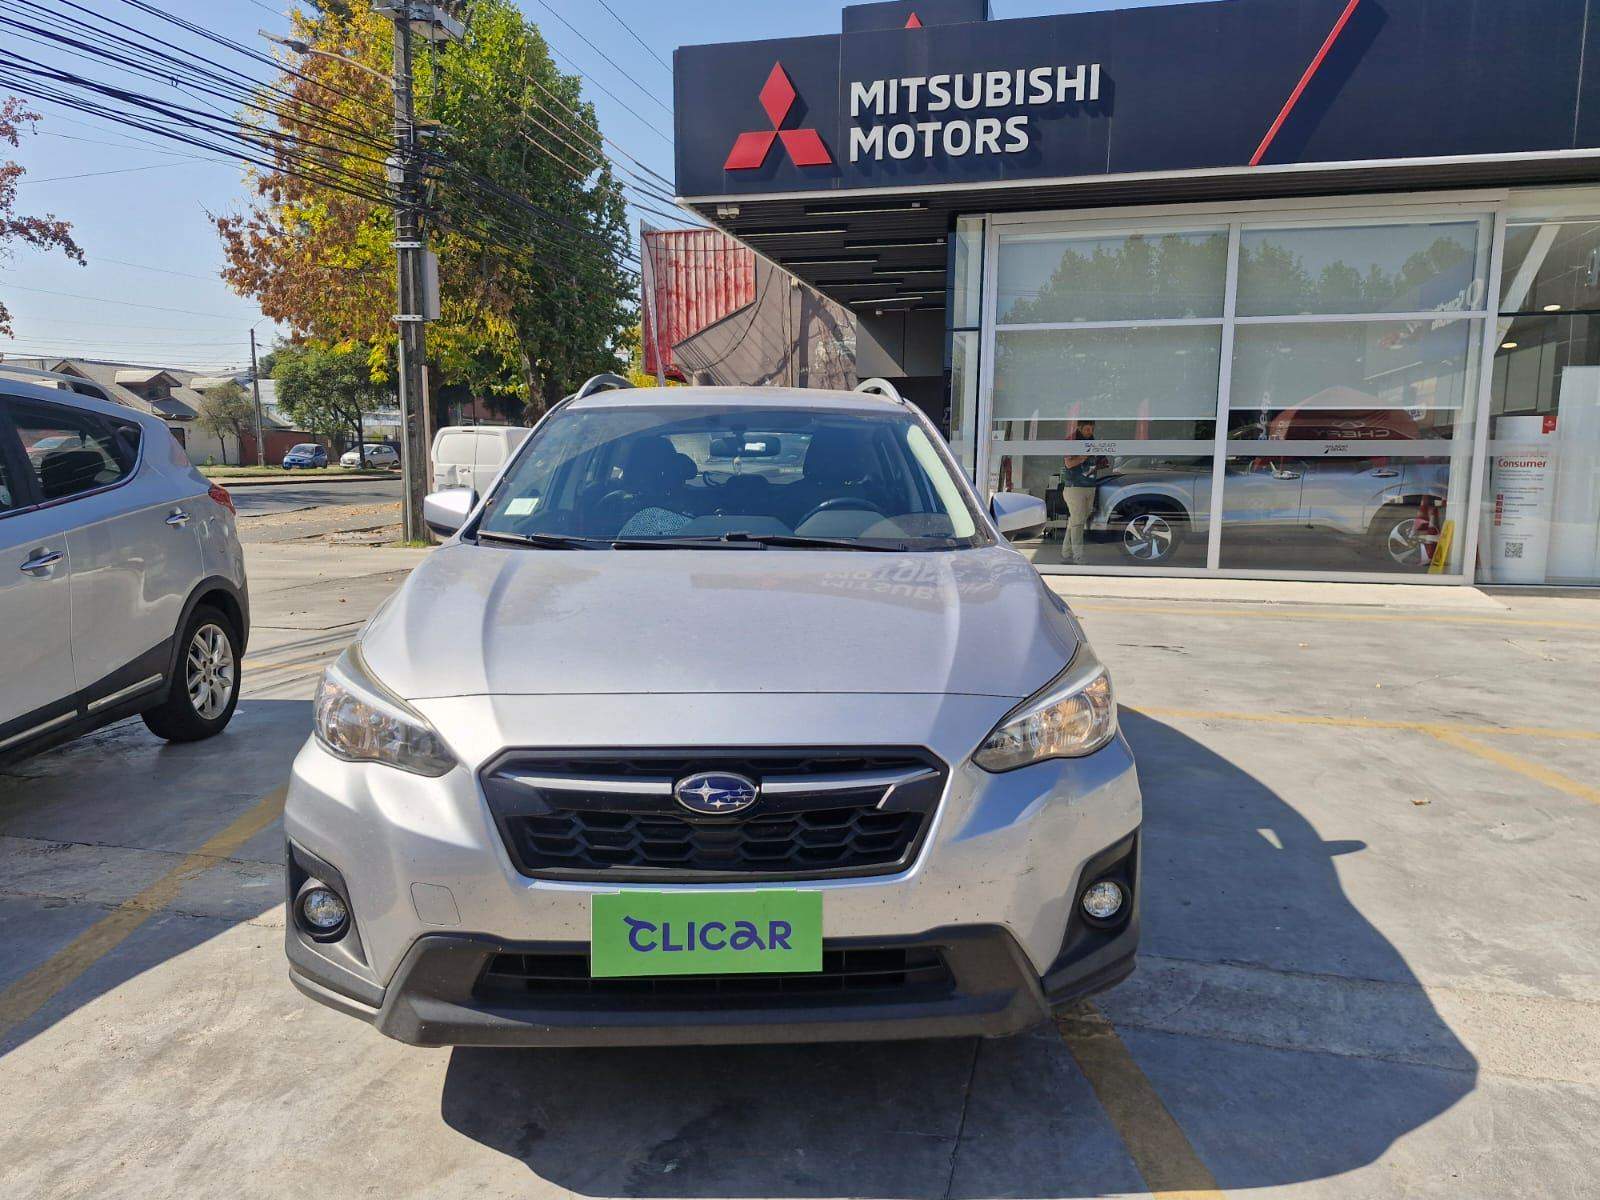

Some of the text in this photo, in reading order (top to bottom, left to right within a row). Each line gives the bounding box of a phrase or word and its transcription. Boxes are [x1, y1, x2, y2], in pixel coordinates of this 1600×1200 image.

[850, 64, 1100, 117] MITSUBISHI
[850, 115, 1029, 162] MOTORS
[1497, 458, 1547, 468] Consumer
